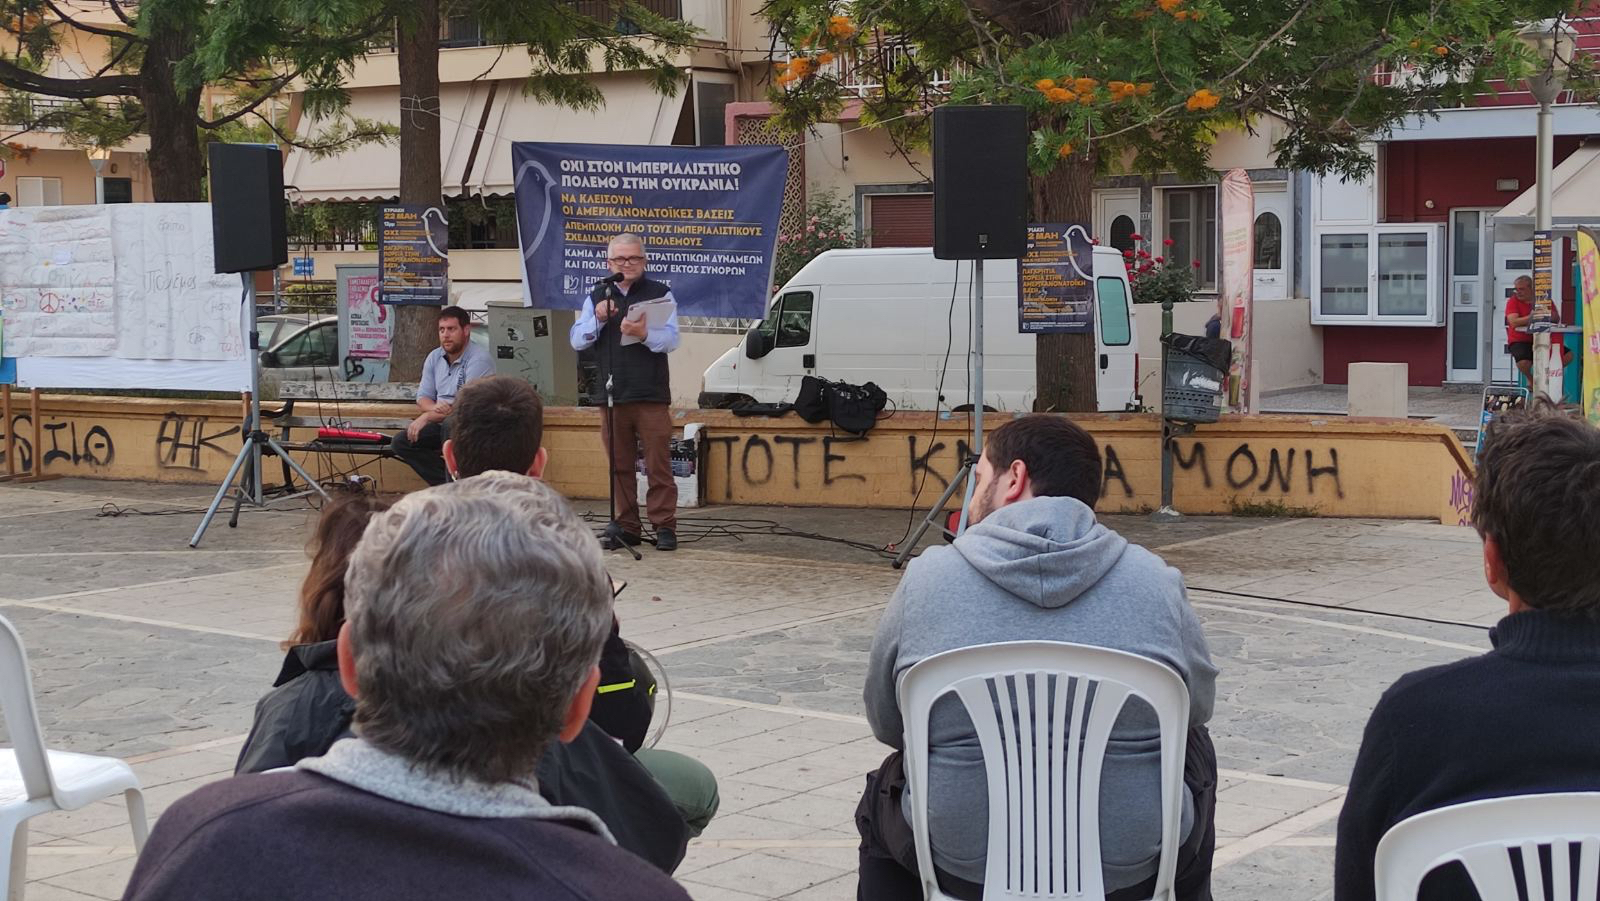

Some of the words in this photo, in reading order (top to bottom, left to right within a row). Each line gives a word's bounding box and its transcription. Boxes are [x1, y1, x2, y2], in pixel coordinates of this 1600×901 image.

[561, 160, 585, 172] ΟΧΙ
[587, 160, 624, 173] ΣΤΟΝ
[626, 162, 741, 176] ΙΜΠΕΡΙΑΛΙΣΤΙΚΟ
[561, 175, 620, 189] ΠΟΛΕΜΟ
[622, 177, 659, 190] ΣΤΗΝ
[661, 178, 740, 191] ΟΥΚΡΑΝΙΑ!
[561, 193, 577, 203] ΝΑ
[580, 194, 633, 204] ΚΛΕΙΣΟΥΝ
[562, 205, 574, 215] ΟΙ
[576, 206, 694, 219] ΑΜΕΡΙΚΑΝΟΝΑΤΟΪΚΕΣ
[696, 209, 735, 220] ΒΑΣΕΙΣ
[565, 222, 622, 232] ΑΠΕΜΠΛΟΚΗ
[624, 224, 645, 233] ΑΠΟ
[647, 225, 672, 234] ΤΟΥΣ
[674, 225, 763, 236] ΙΜΠΕΡΙΑΛΙΣΤΙΚΟΥΣ
[648, 236, 703, 246] ΠΟΛΕΜΟΥΣ
[564, 248, 594, 258] ΚΑΜΙΑ
[711, 254, 763, 265] ΔΥΝΑΜΕΩΝ
[564, 260, 580, 269] ΚΑΙ
[670, 264, 699, 274] ΕΚΤΟΣ
[700, 265, 746, 276] ΣΥΝΟΡΩΝ
